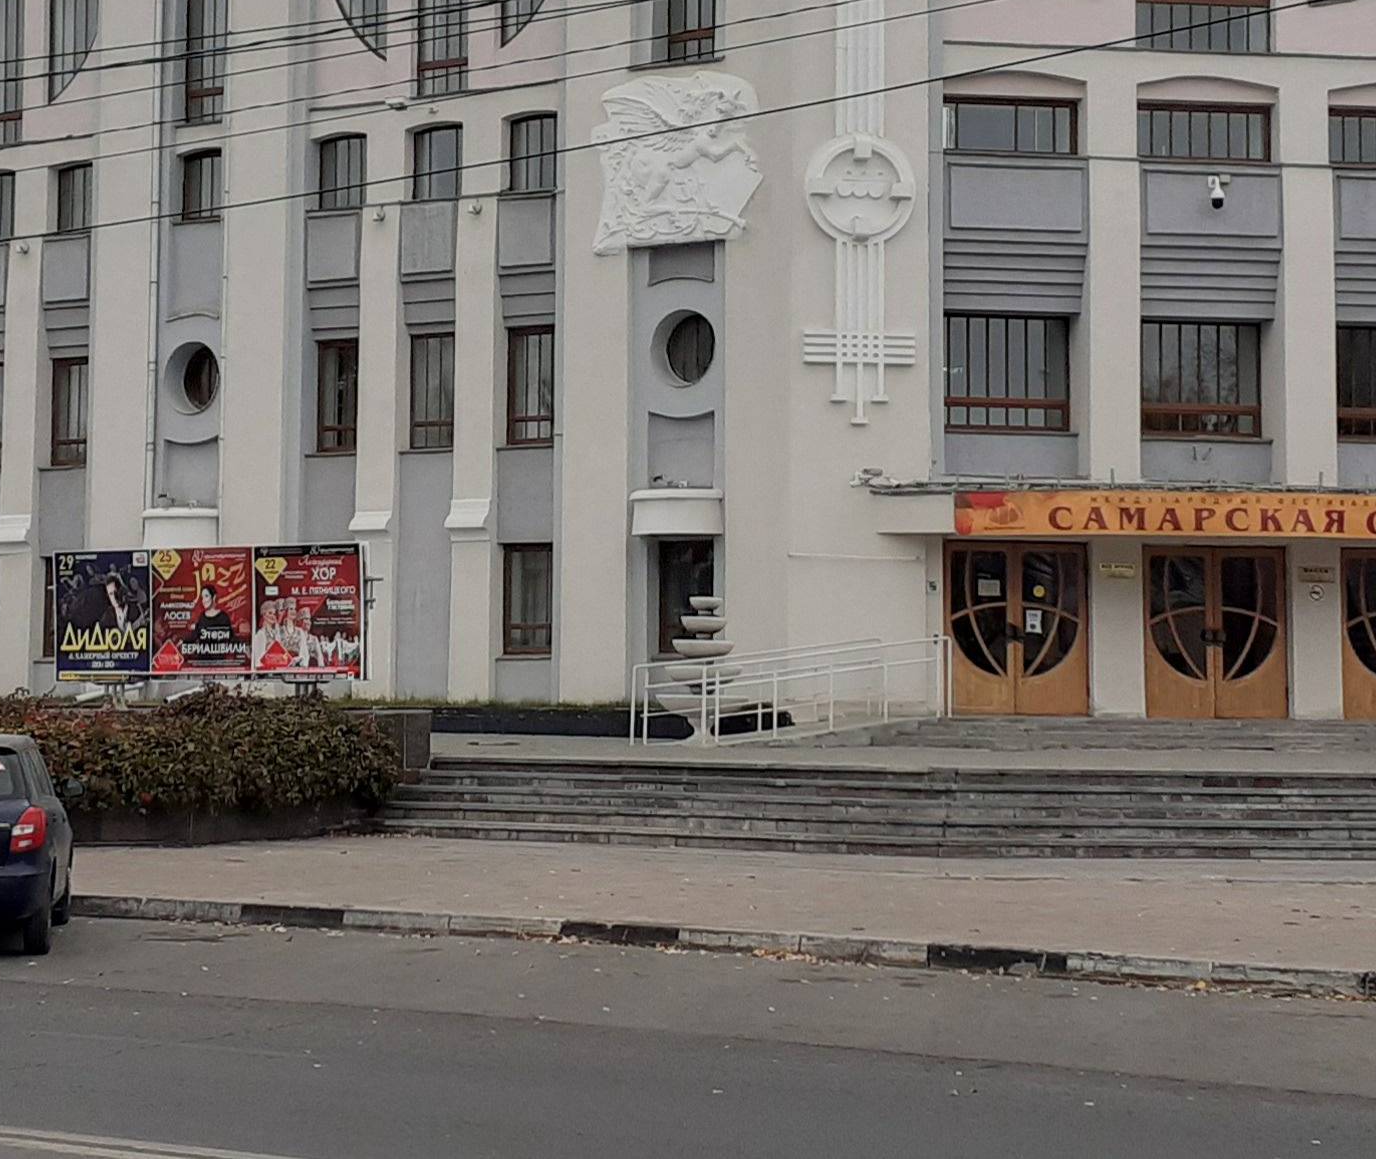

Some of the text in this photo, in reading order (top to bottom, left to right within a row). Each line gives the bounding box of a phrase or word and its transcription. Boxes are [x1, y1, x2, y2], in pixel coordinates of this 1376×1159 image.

[1047, 505, 1346, 535] САМАРСКАЯ
[58, 554, 74, 571] 29
[159, 551, 173, 563] 25
[264, 558, 276, 570] 22
[311, 567, 336, 580] ХОР
[60, 621, 147, 651] ДИДЮЛЯ
[181, 643, 246, 654] БЕРИАШВИЛИ
